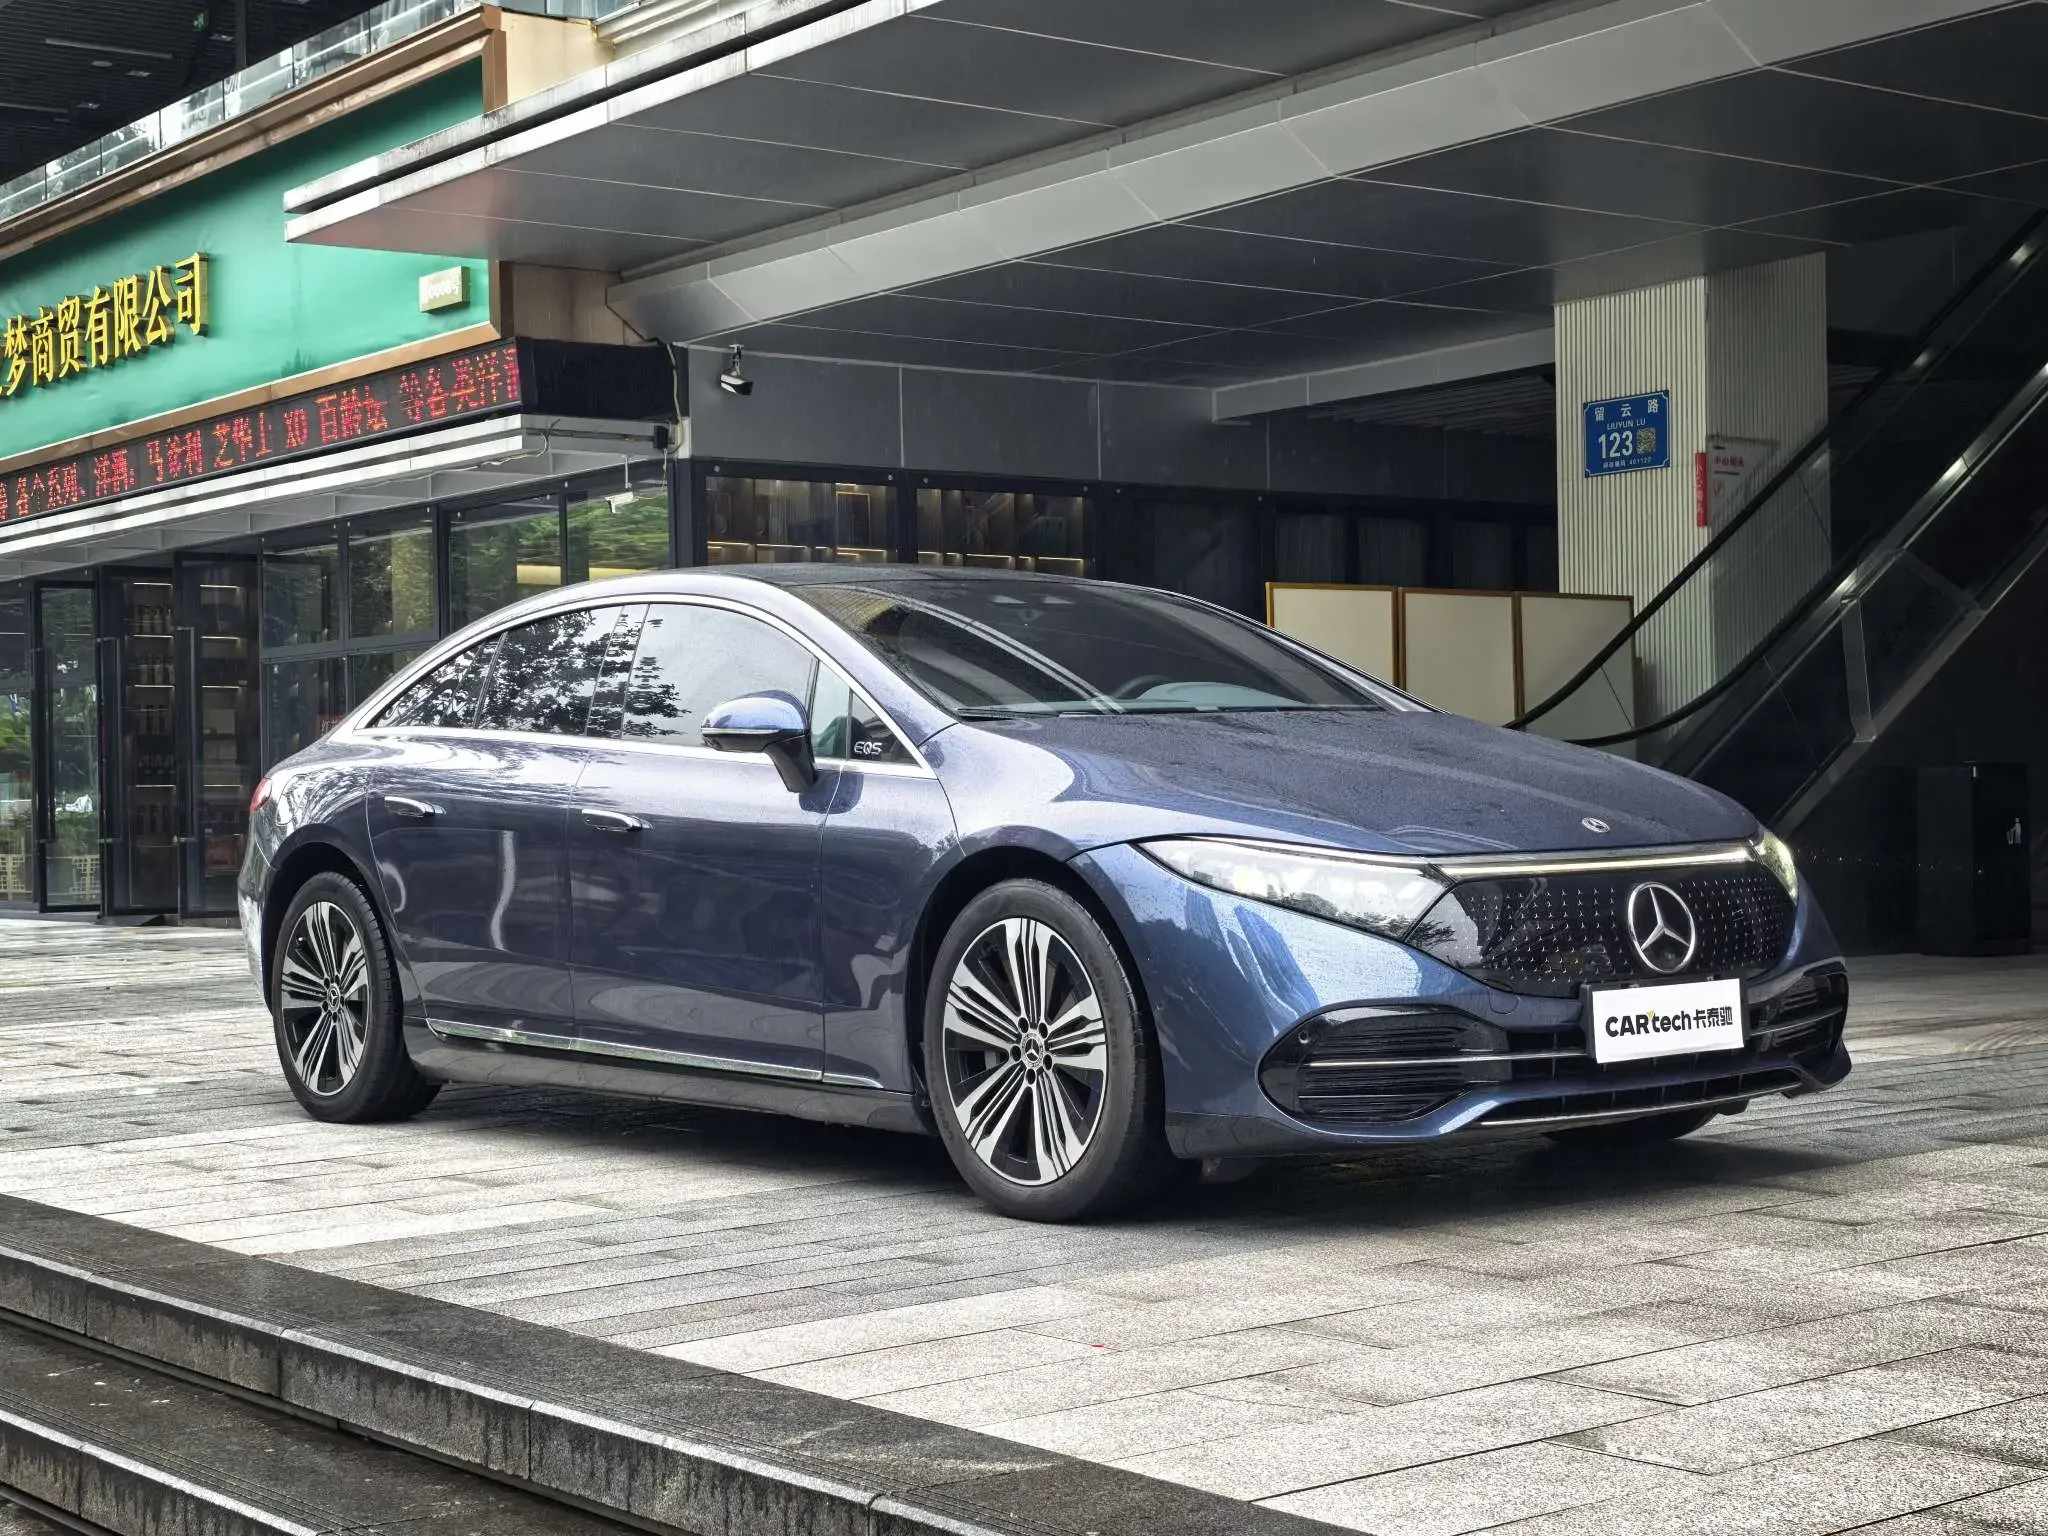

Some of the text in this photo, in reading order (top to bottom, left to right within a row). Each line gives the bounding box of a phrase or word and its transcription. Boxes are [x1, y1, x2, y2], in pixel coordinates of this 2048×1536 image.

[0, 252, 202, 396] 梦商贸有限公司
[1594, 399, 1659, 422] 留云路
[1607, 418, 1646, 430] LIUYUN LU
[1598, 430, 1633, 459] 123
[853, 741, 883, 755] EQS
[1605, 1006, 1733, 1037] CARtech 卡泰驰
